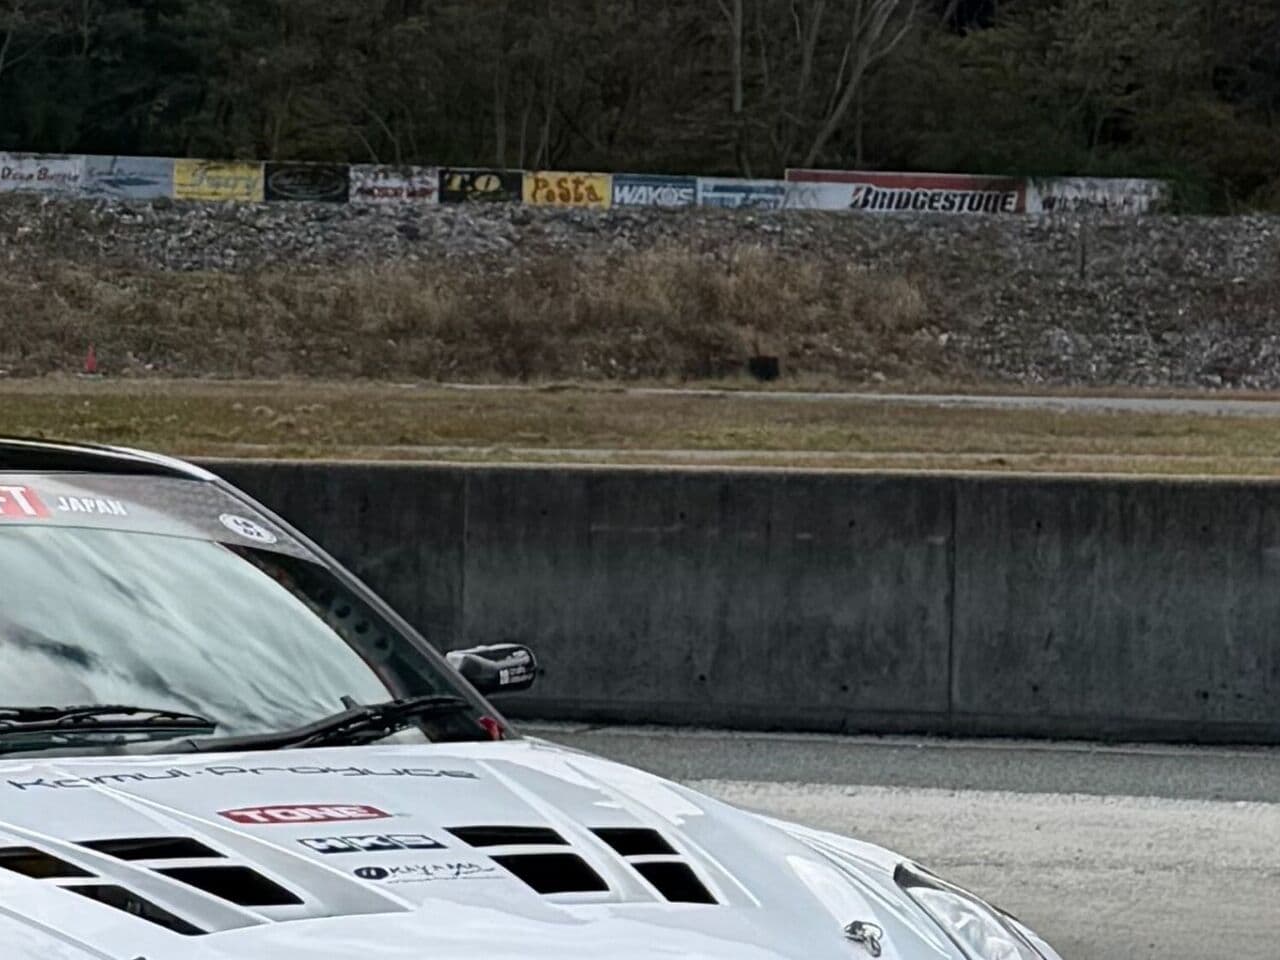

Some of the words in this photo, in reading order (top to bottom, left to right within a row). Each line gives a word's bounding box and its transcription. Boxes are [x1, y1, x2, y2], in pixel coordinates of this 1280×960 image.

[851, 185, 1018, 213] BRIDGESTONE
[58, 496, 128, 516] JAPAN
[230, 805, 380, 823] TONE
